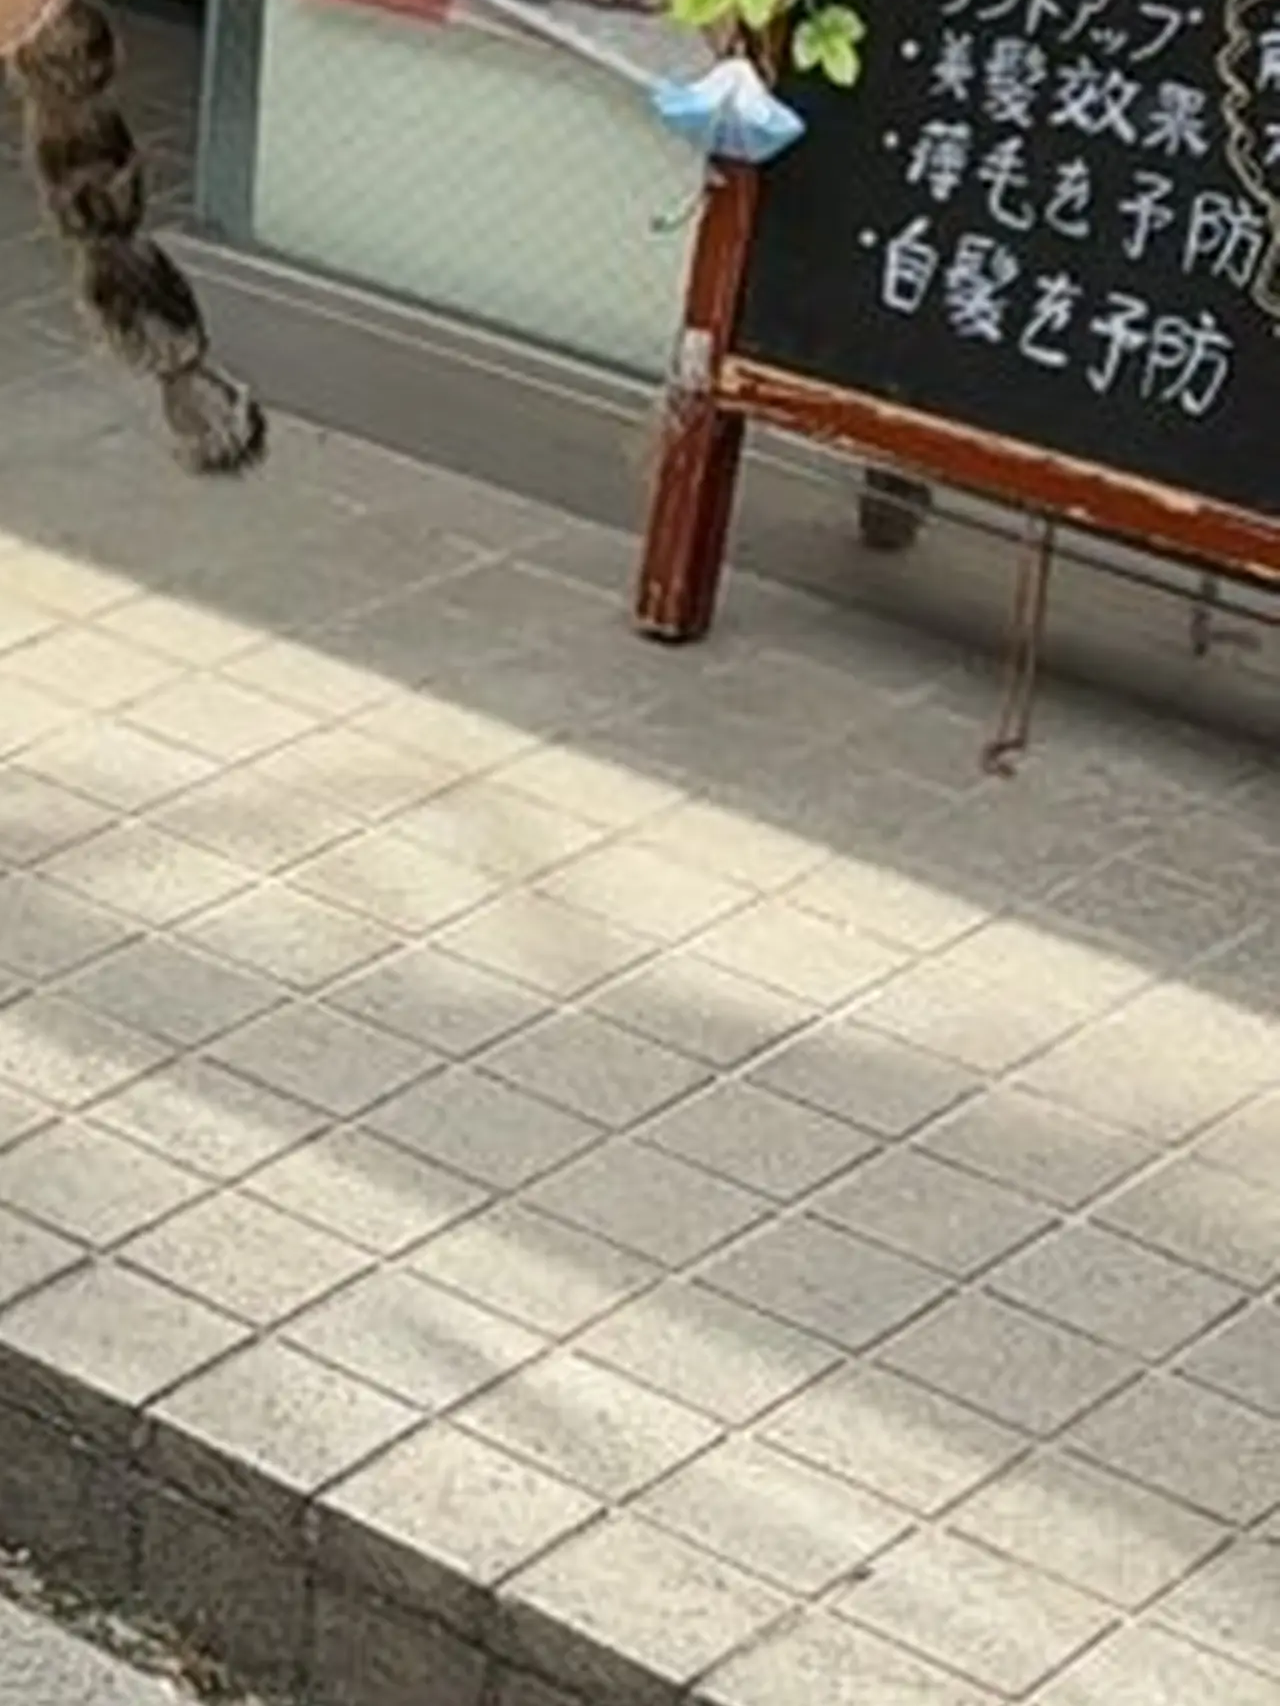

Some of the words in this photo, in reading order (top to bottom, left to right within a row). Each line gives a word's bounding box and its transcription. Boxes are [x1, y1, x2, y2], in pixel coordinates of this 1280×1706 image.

[904, 116, 1266, 290] 薄毛を予防
